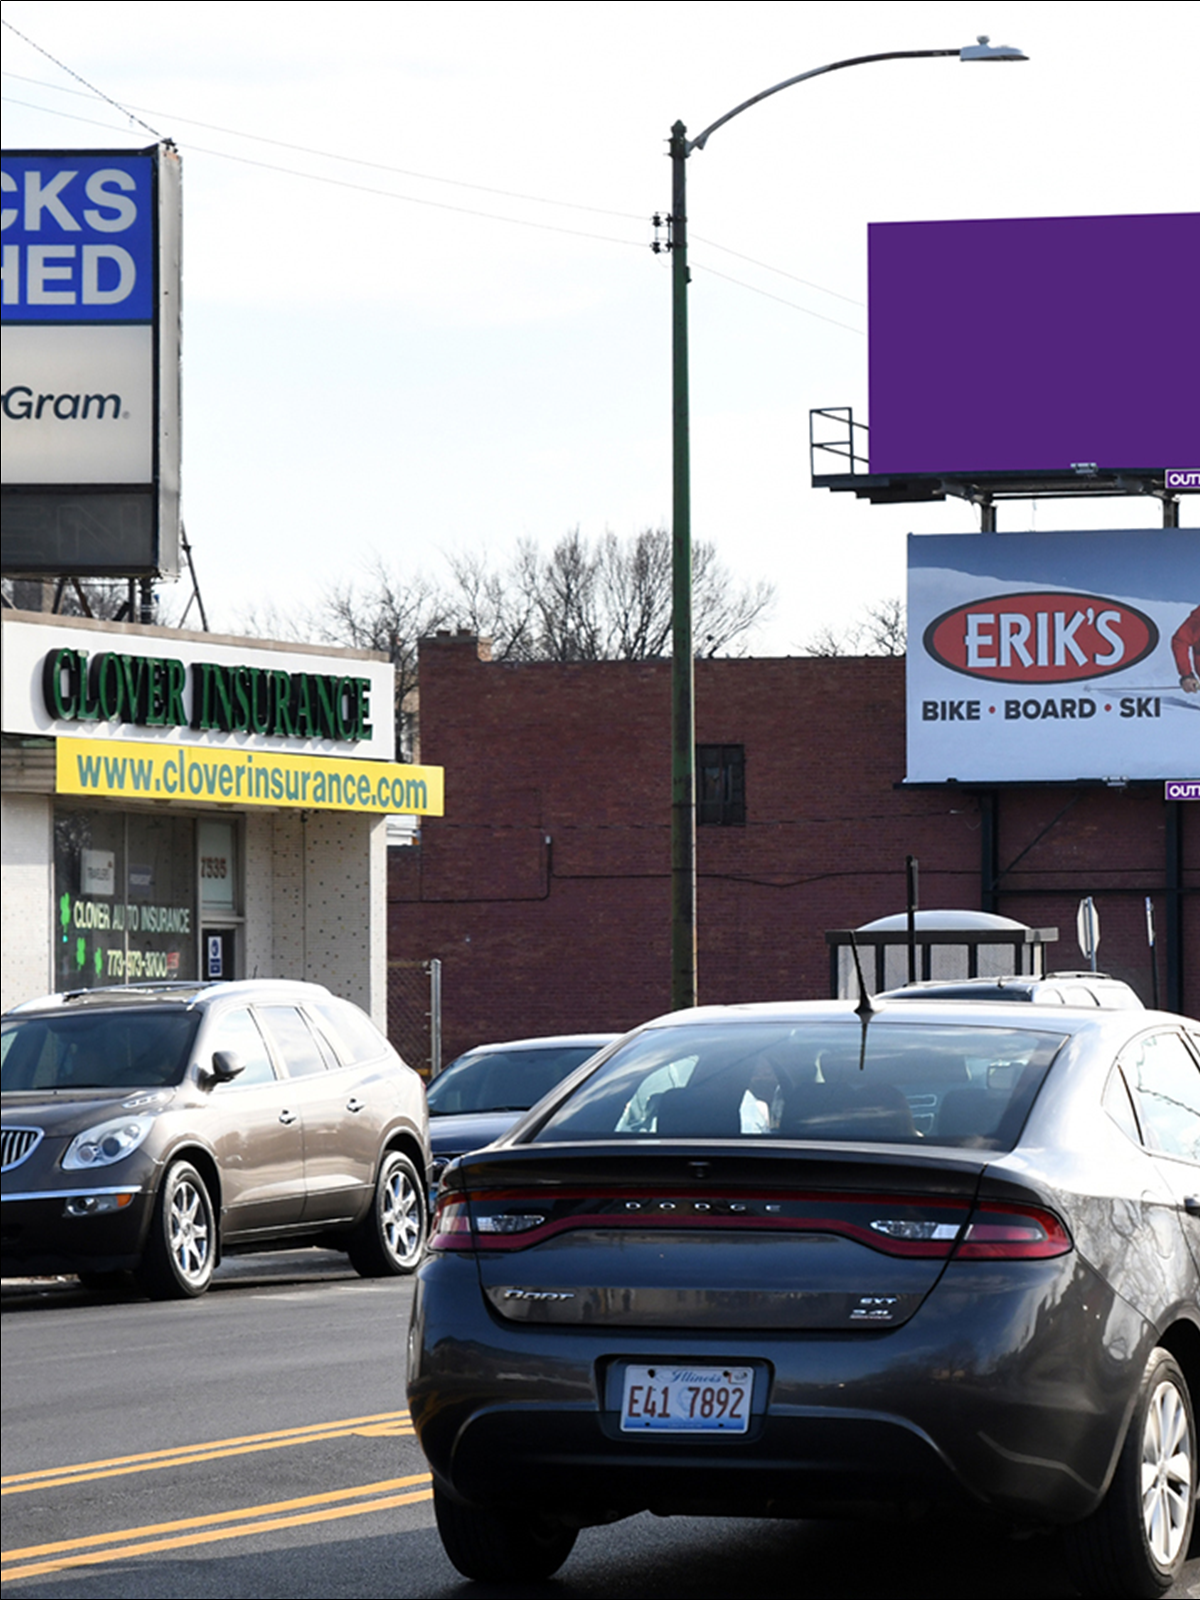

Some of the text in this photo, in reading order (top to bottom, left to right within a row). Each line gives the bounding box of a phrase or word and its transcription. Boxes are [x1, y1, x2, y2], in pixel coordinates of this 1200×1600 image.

[1, 386, 122, 420] Gram
[965, 608, 1125, 669] ERIK'S
[44, 648, 374, 742] CLOVER INSURANCE
[921, 697, 1161, 722] BIKE BOARD SKI
[76, 749, 428, 810] www.cloverinsurance.com
[201, 857, 227, 879] 7535
[73, 900, 190, 934] CLOVER AUTO INSURANCE
[625, 1202, 781, 1212] DODGE
[672, 1370, 722, 1383] Illinois
[628, 1386, 745, 1419] E41 7892
